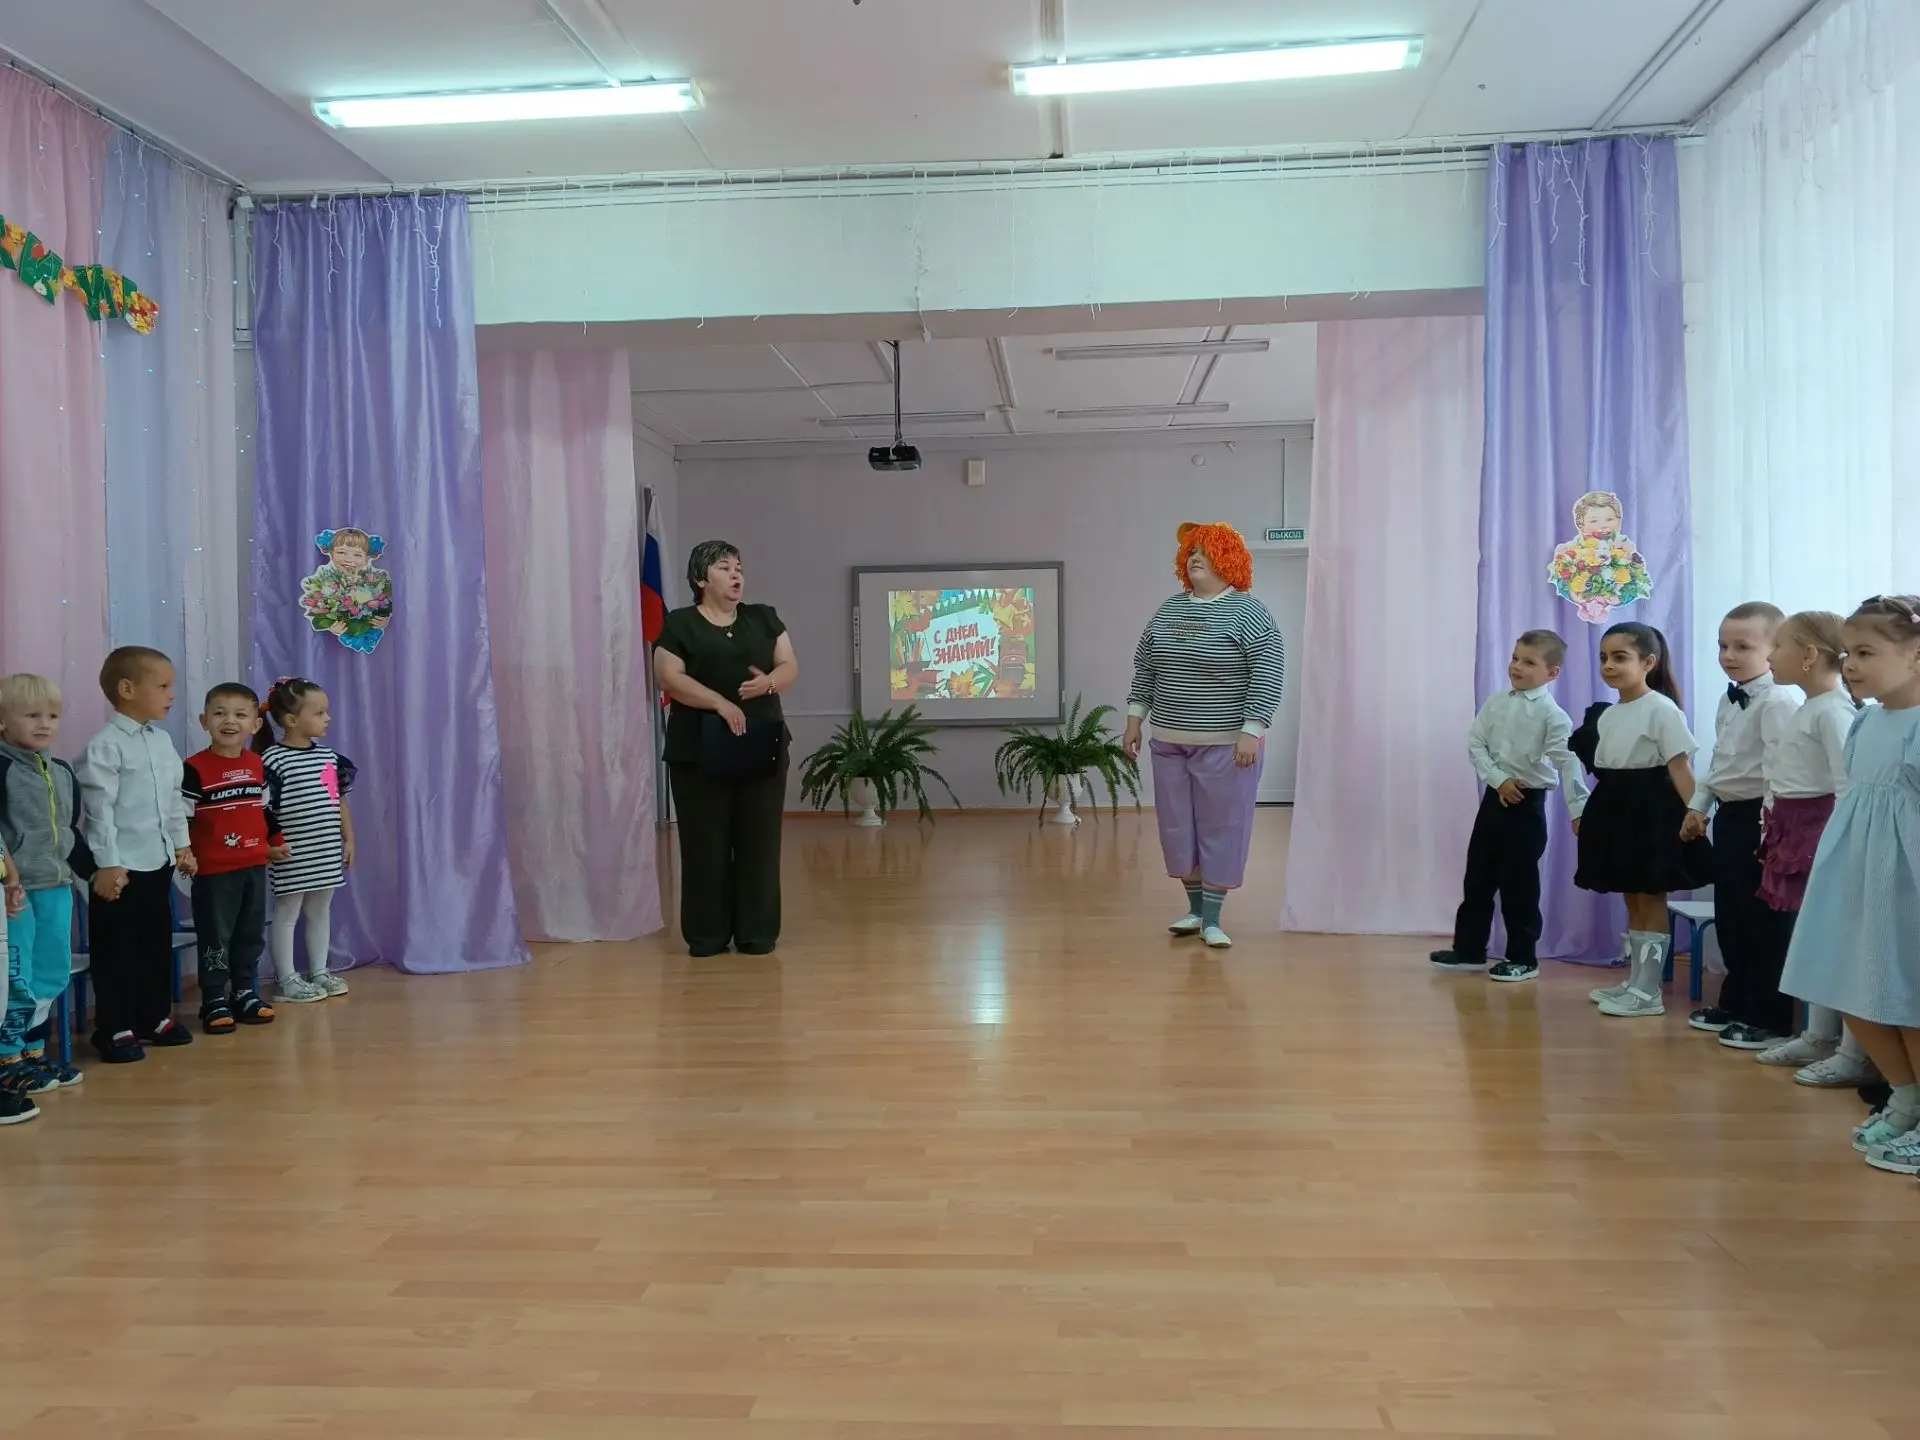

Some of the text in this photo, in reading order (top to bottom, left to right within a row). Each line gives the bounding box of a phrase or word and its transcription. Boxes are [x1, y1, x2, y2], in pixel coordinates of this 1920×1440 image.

[1270, 531, 1302, 539] ВЫХОД
[934, 630, 941, 644] С
[932, 635, 996, 665] ЗНАНИЙ!
[211, 788, 243, 800] LUCKY
